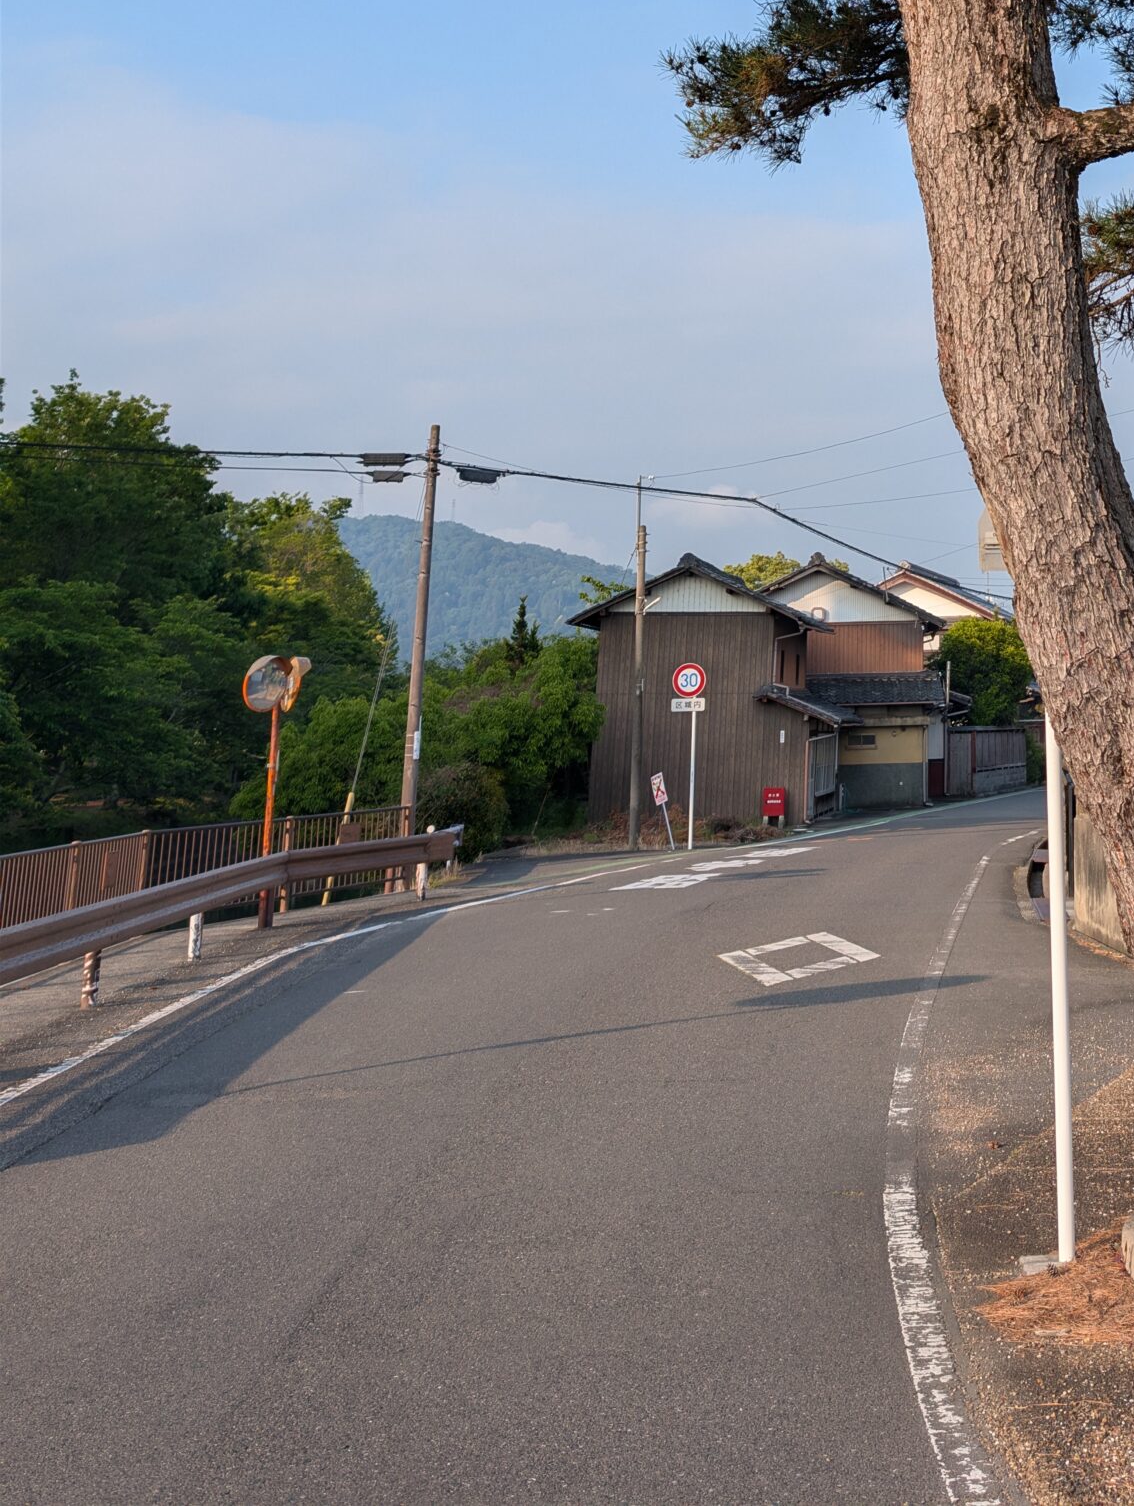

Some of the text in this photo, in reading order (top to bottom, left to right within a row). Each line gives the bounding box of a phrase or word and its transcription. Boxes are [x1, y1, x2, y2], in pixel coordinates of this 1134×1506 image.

[680, 673, 698, 688] 30
[676, 700, 702, 710] 区域内
